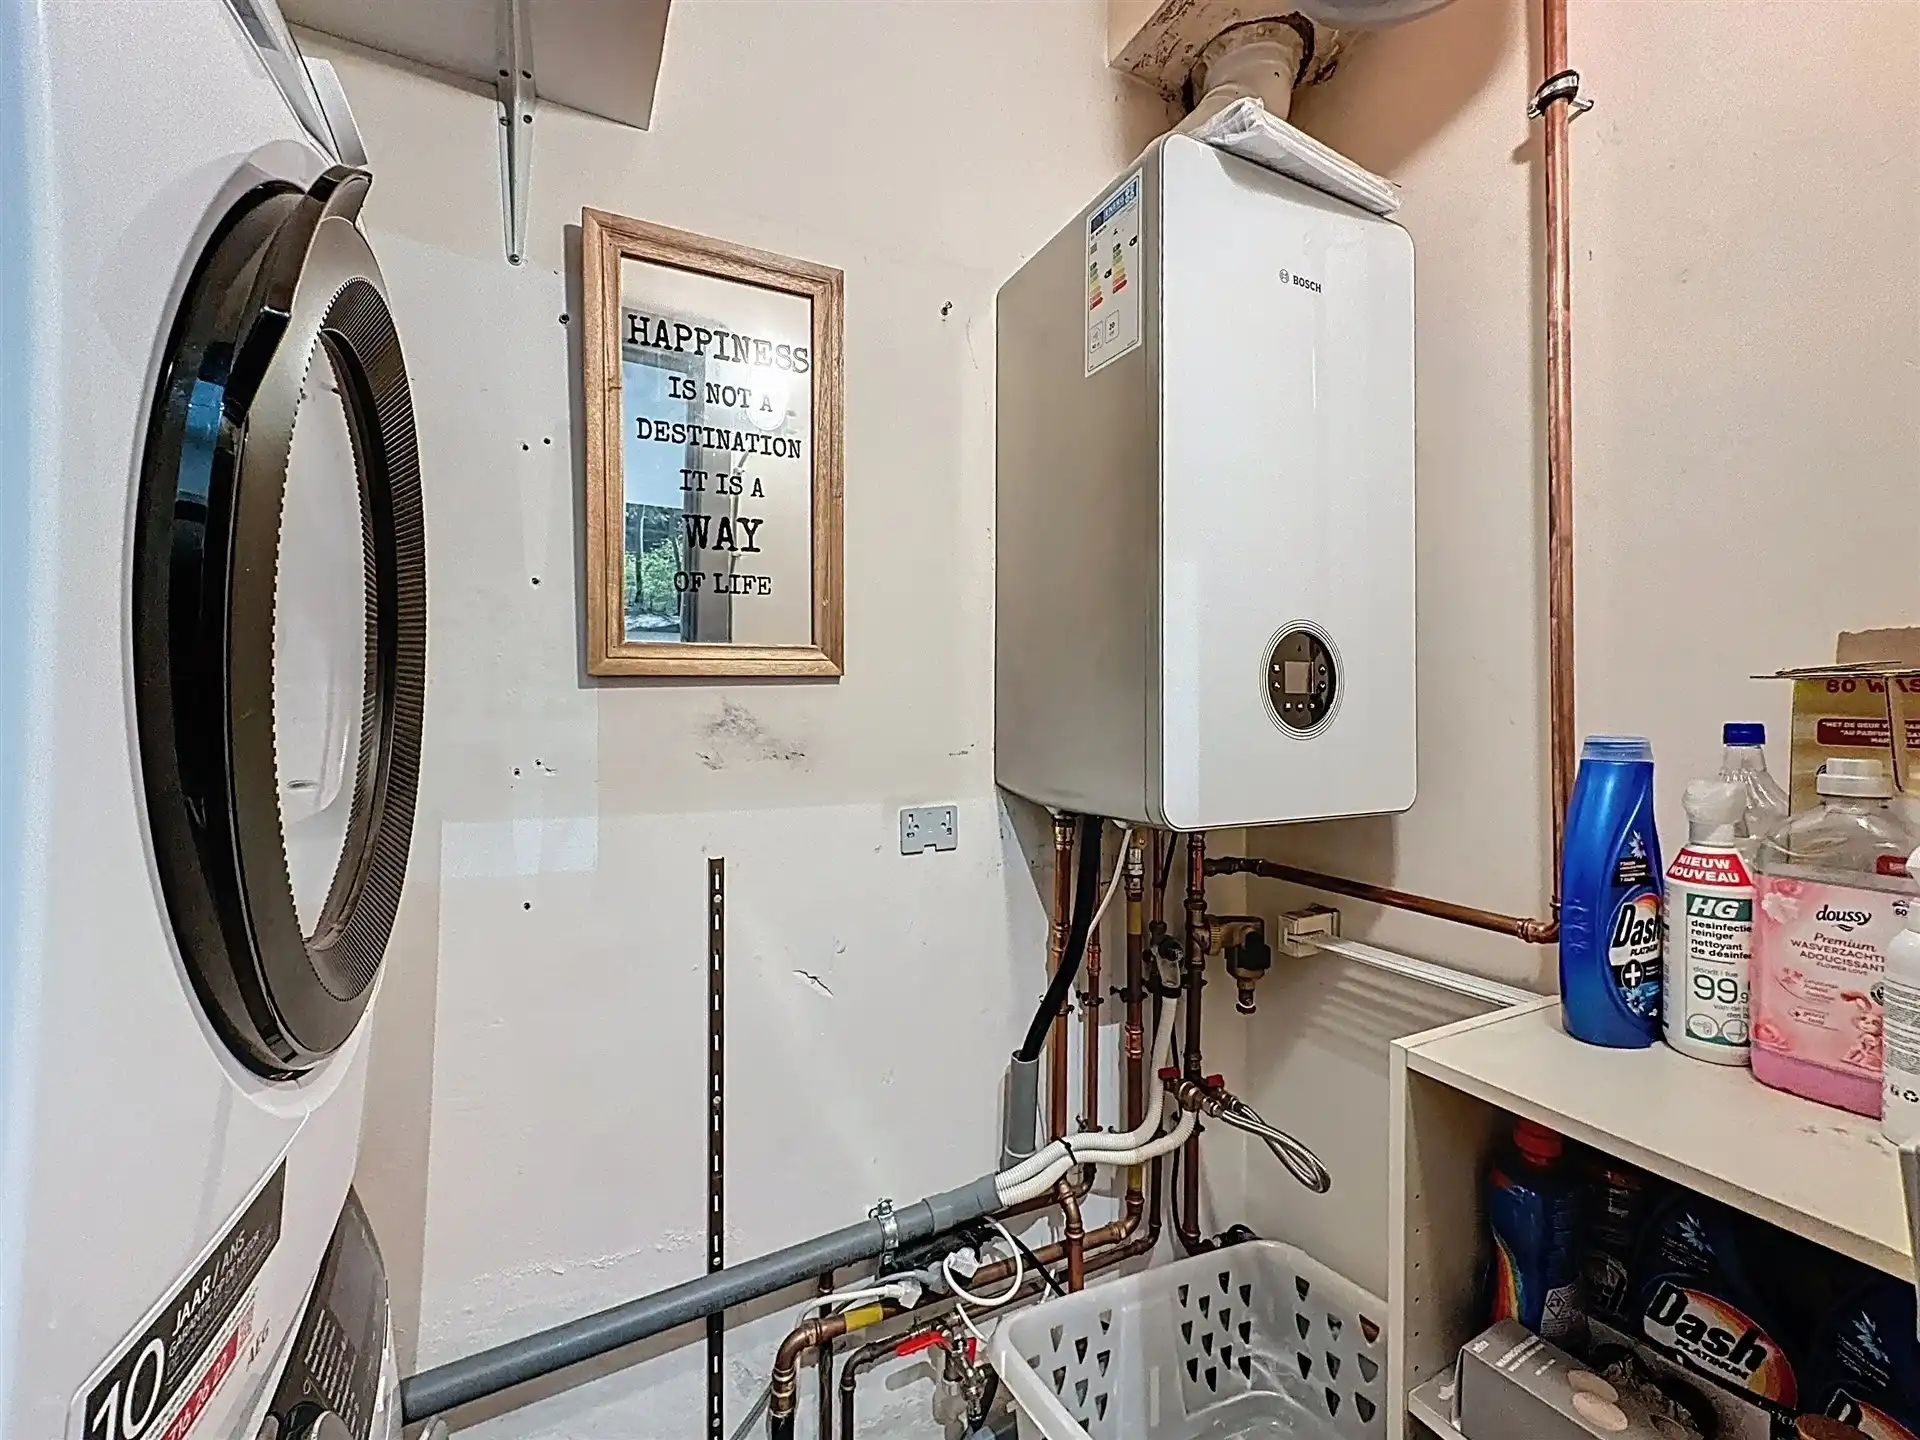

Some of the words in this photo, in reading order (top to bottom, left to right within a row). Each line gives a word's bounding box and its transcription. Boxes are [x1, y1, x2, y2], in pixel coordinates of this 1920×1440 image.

[1292, 274, 1321, 293] BOSCH
[627, 314, 810, 374] HAPPINESS
[668, 376, 697, 400] IS
[705, 383, 752, 408] NOT
[758, 393, 773, 413] A
[636, 416, 802, 459] DESTINATION
[679, 469, 708, 492] IT
[715, 472, 743, 496] IS
[750, 479, 765, 499] A
[682, 514, 764, 553] WAY
[673, 571, 706, 593] OF
[713, 572, 772, 596] LIFE
[1678, 854, 1730, 870] NIEUW
[1670, 864, 1740, 883] NOUVEAU
[1690, 897, 1739, 918] HG
[1816, 904, 1872, 926] doussy
[1895, 908, 1908, 917] 60
[1691, 919, 1752, 932] desinfectie
[1691, 929, 1734, 940] reiniger
[1691, 939, 1743, 951] nettoyant
[1814, 932, 1877, 953] Premium
[1816, 961, 1847, 975] FLOWER
[172, 1274, 211, 1336] JAAR
[220, 1229, 246, 1277] ANS
[1646, 1287, 1767, 1374] Dash
[92, 1337, 165, 1440] 10
